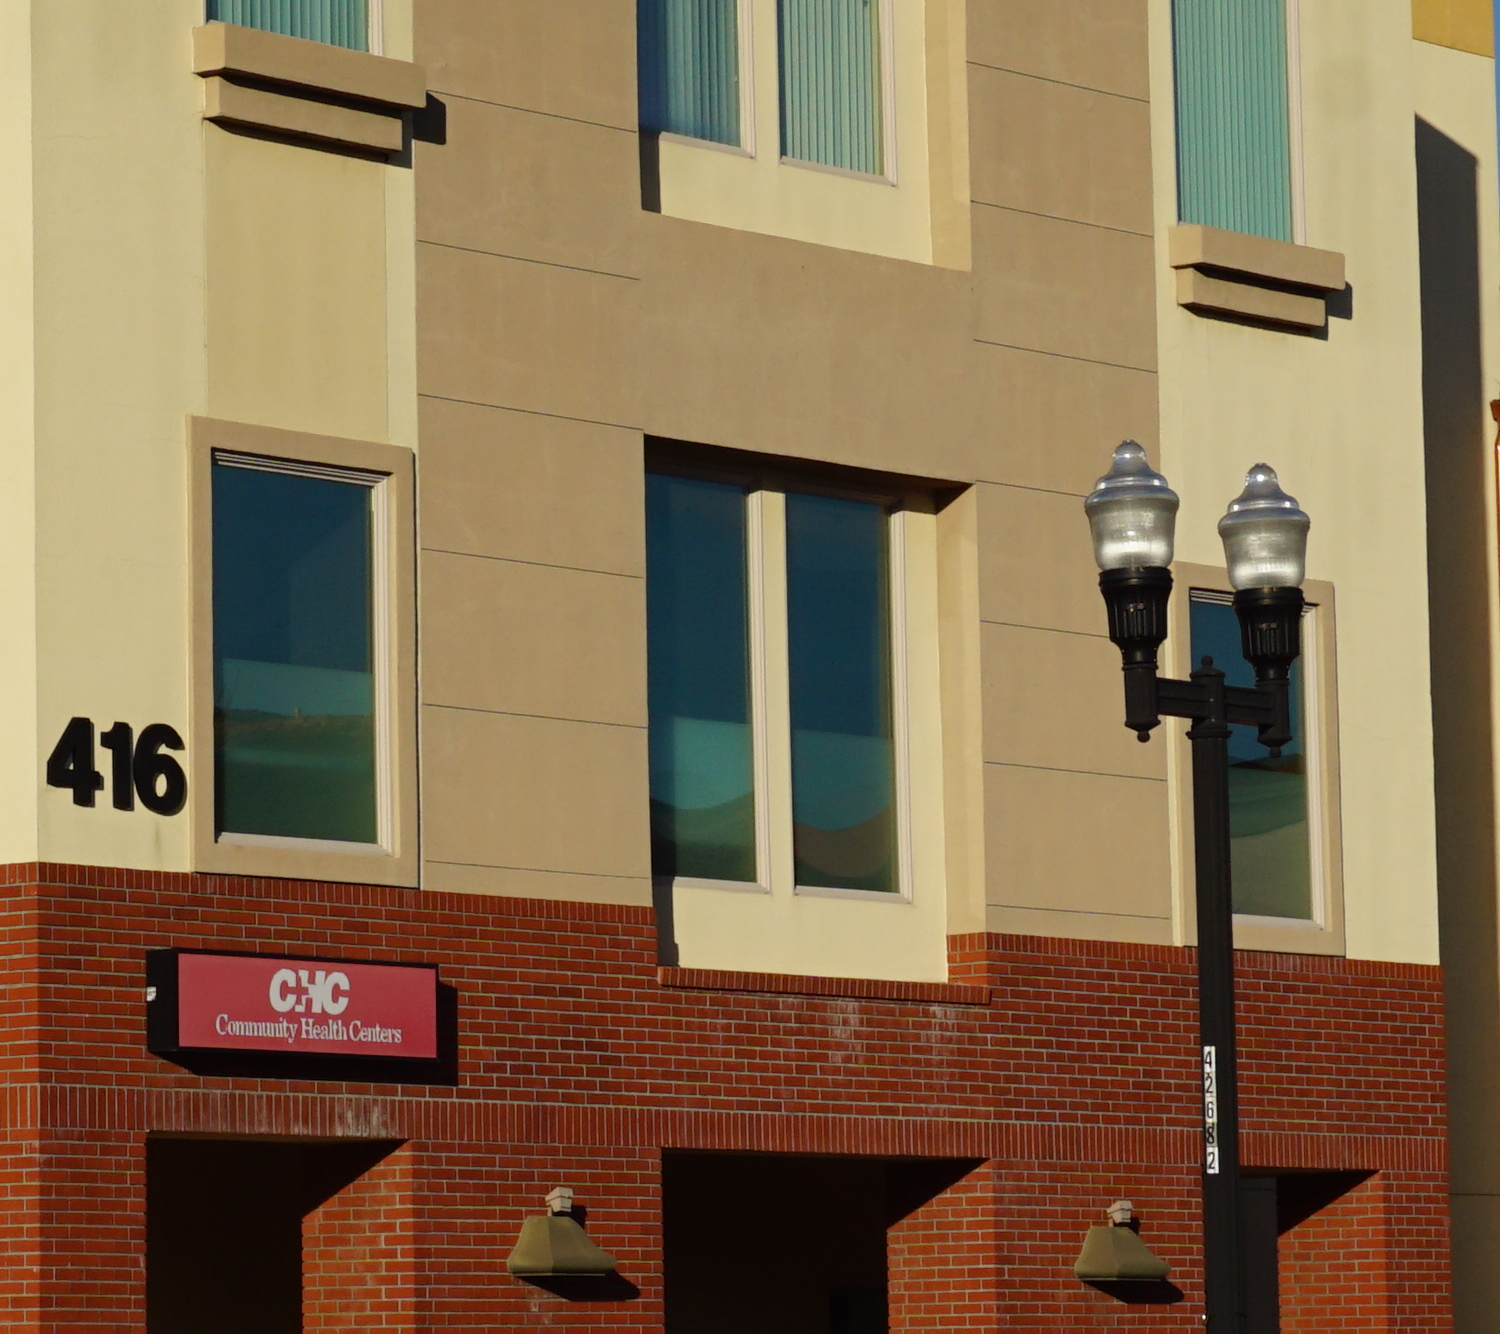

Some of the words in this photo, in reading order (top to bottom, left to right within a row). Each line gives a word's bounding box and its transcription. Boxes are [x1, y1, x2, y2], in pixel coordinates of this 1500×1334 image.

[46, 716, 188, 816] 416
[268, 968, 350, 1015] CHC
[215, 1013, 299, 1044] Community
[300, 1018, 348, 1042] Health
[349, 1020, 403, 1044] Centers
[1204, 1051, 1217, 1170] 42682
